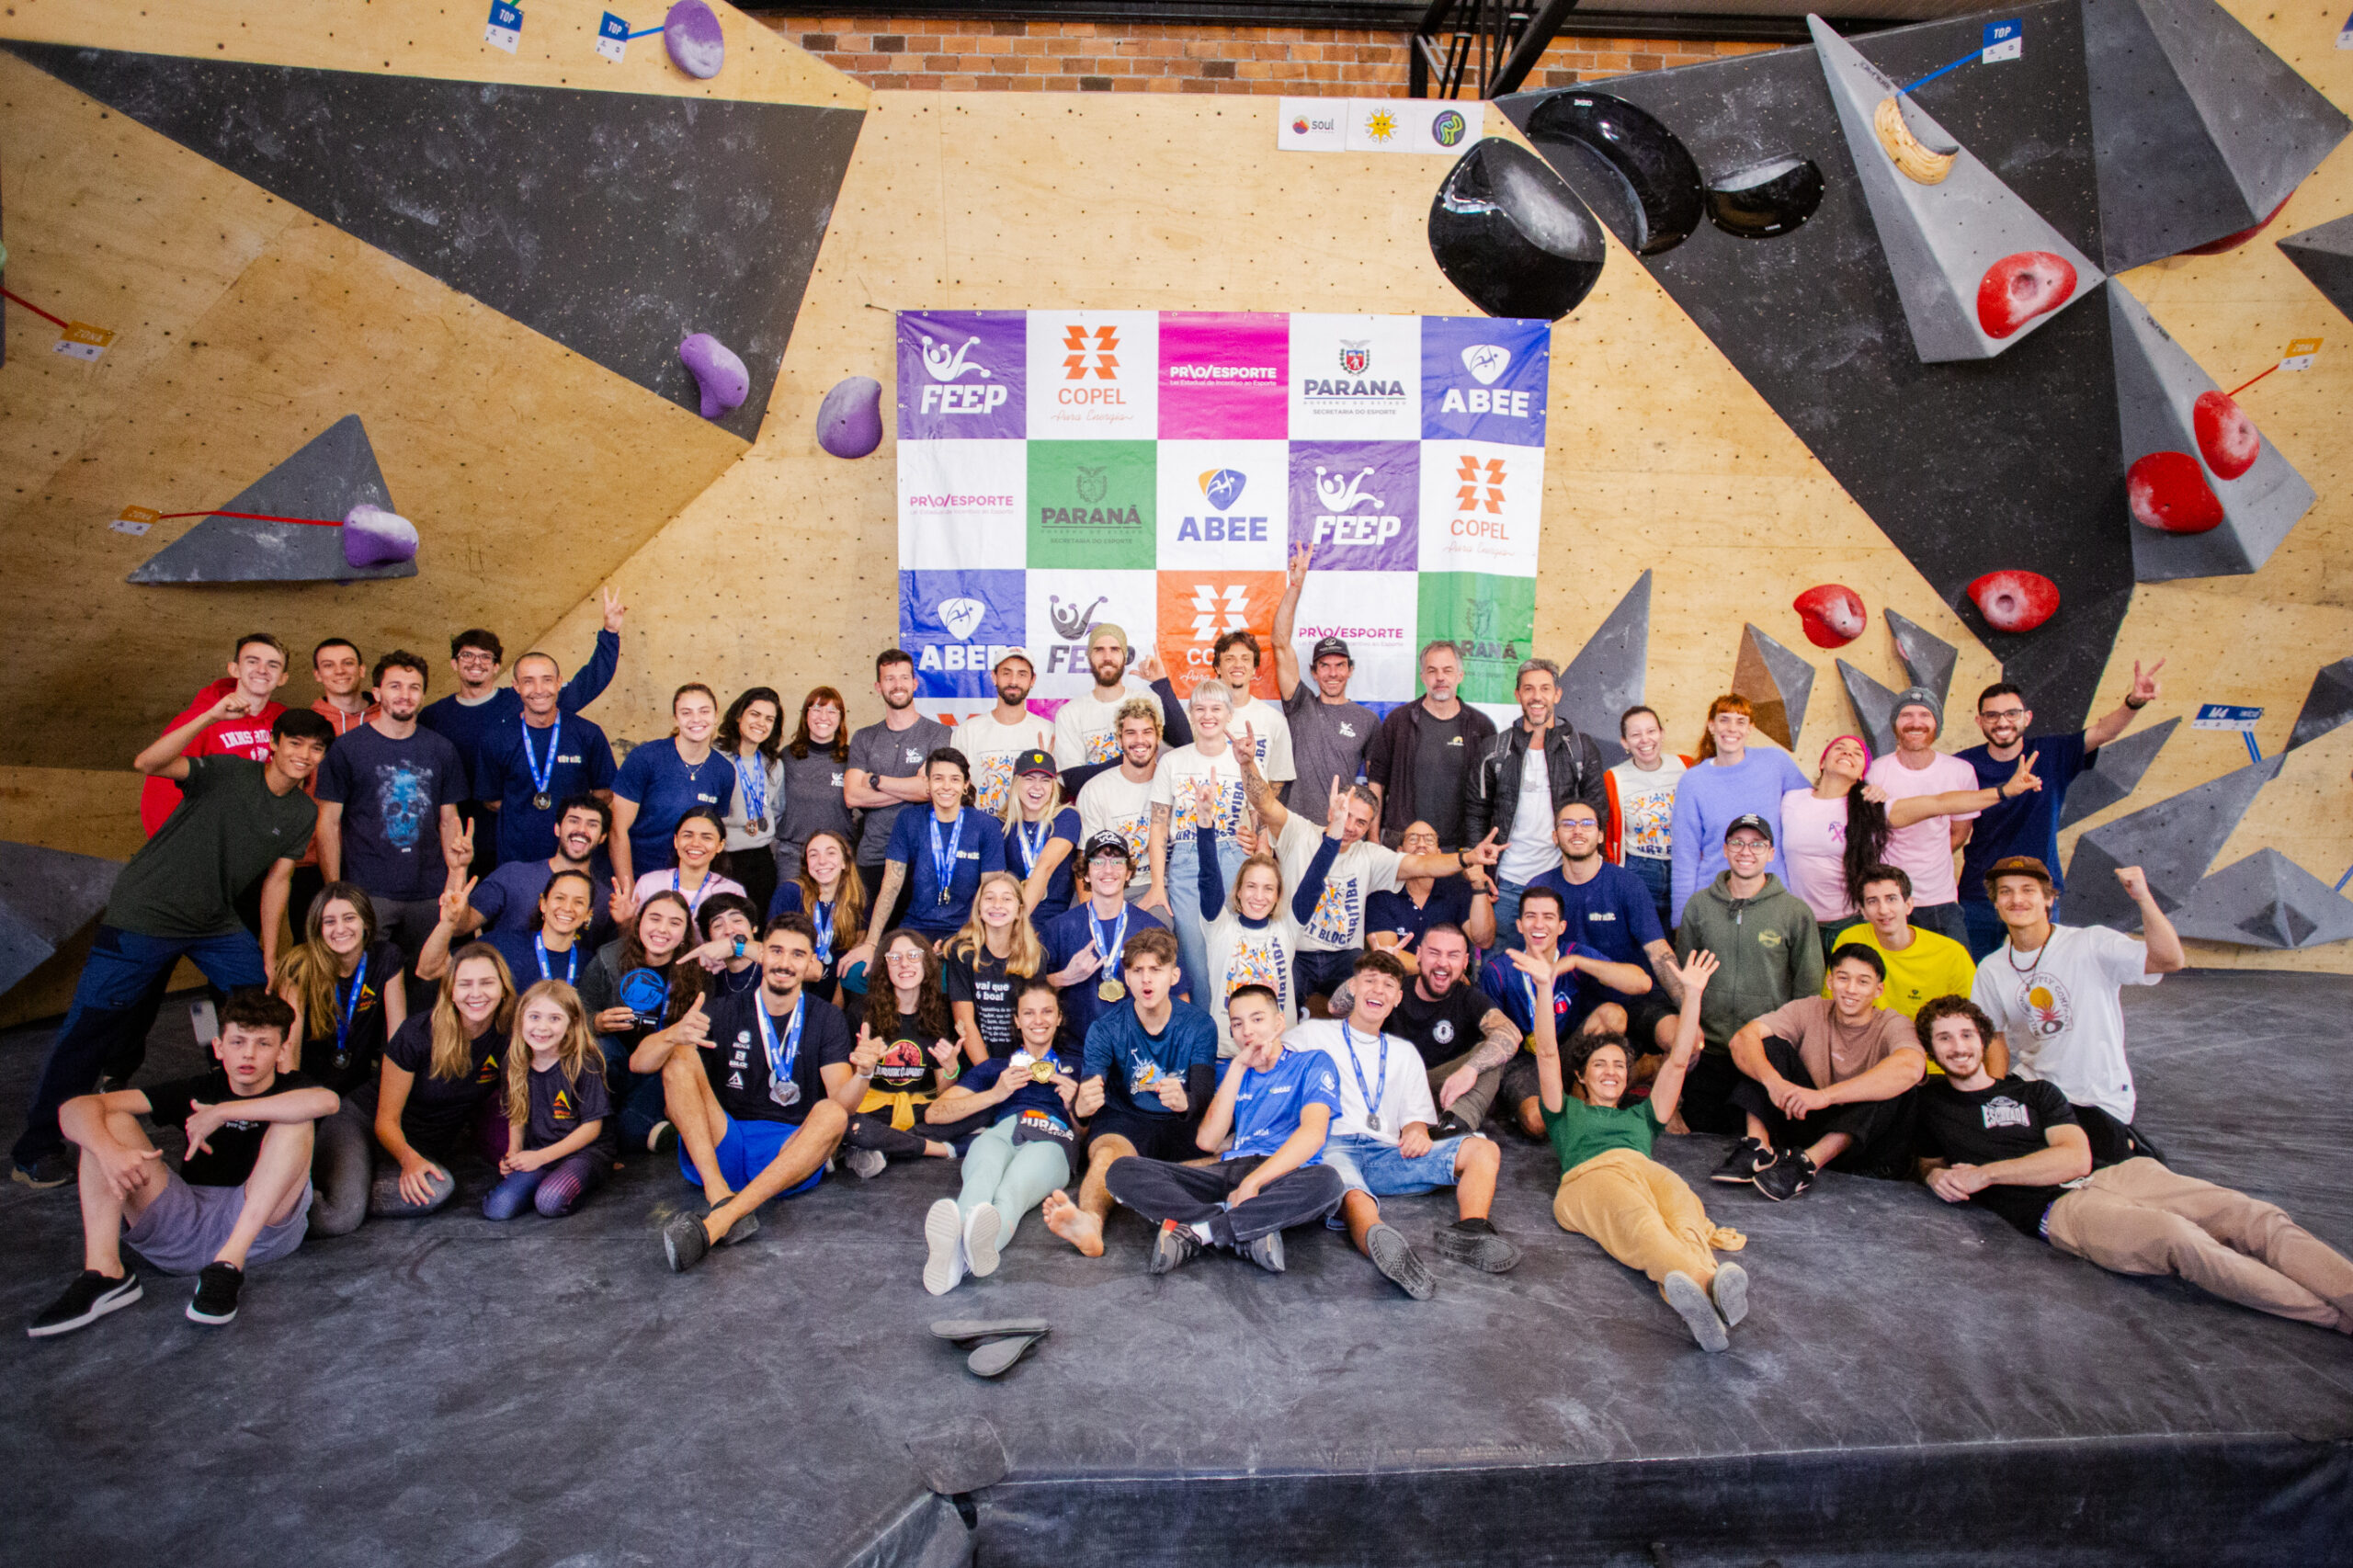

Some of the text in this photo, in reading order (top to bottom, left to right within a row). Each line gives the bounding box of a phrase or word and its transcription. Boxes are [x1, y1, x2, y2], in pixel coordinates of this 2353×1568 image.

[499, 9, 515, 24] TOP
[608, 21, 622, 35] TOP
[1994, 26, 2012, 40] TOP
[1311, 118, 1335, 131] soul
[920, 384, 1007, 415] FEEP
[1058, 388, 1127, 404] COPEL
[1440, 389, 1529, 418] ABEE
[1041, 505, 1142, 525] PARANÁ
[1176, 517, 1267, 541] ABEE
[1313, 516, 1402, 545] FEEP
[1450, 519, 1509, 540] COPEL
[1431, 640, 1518, 660] RANÁ
[1319, 928, 1347, 945] BLOC
[975, 981, 1009, 993] vai que
